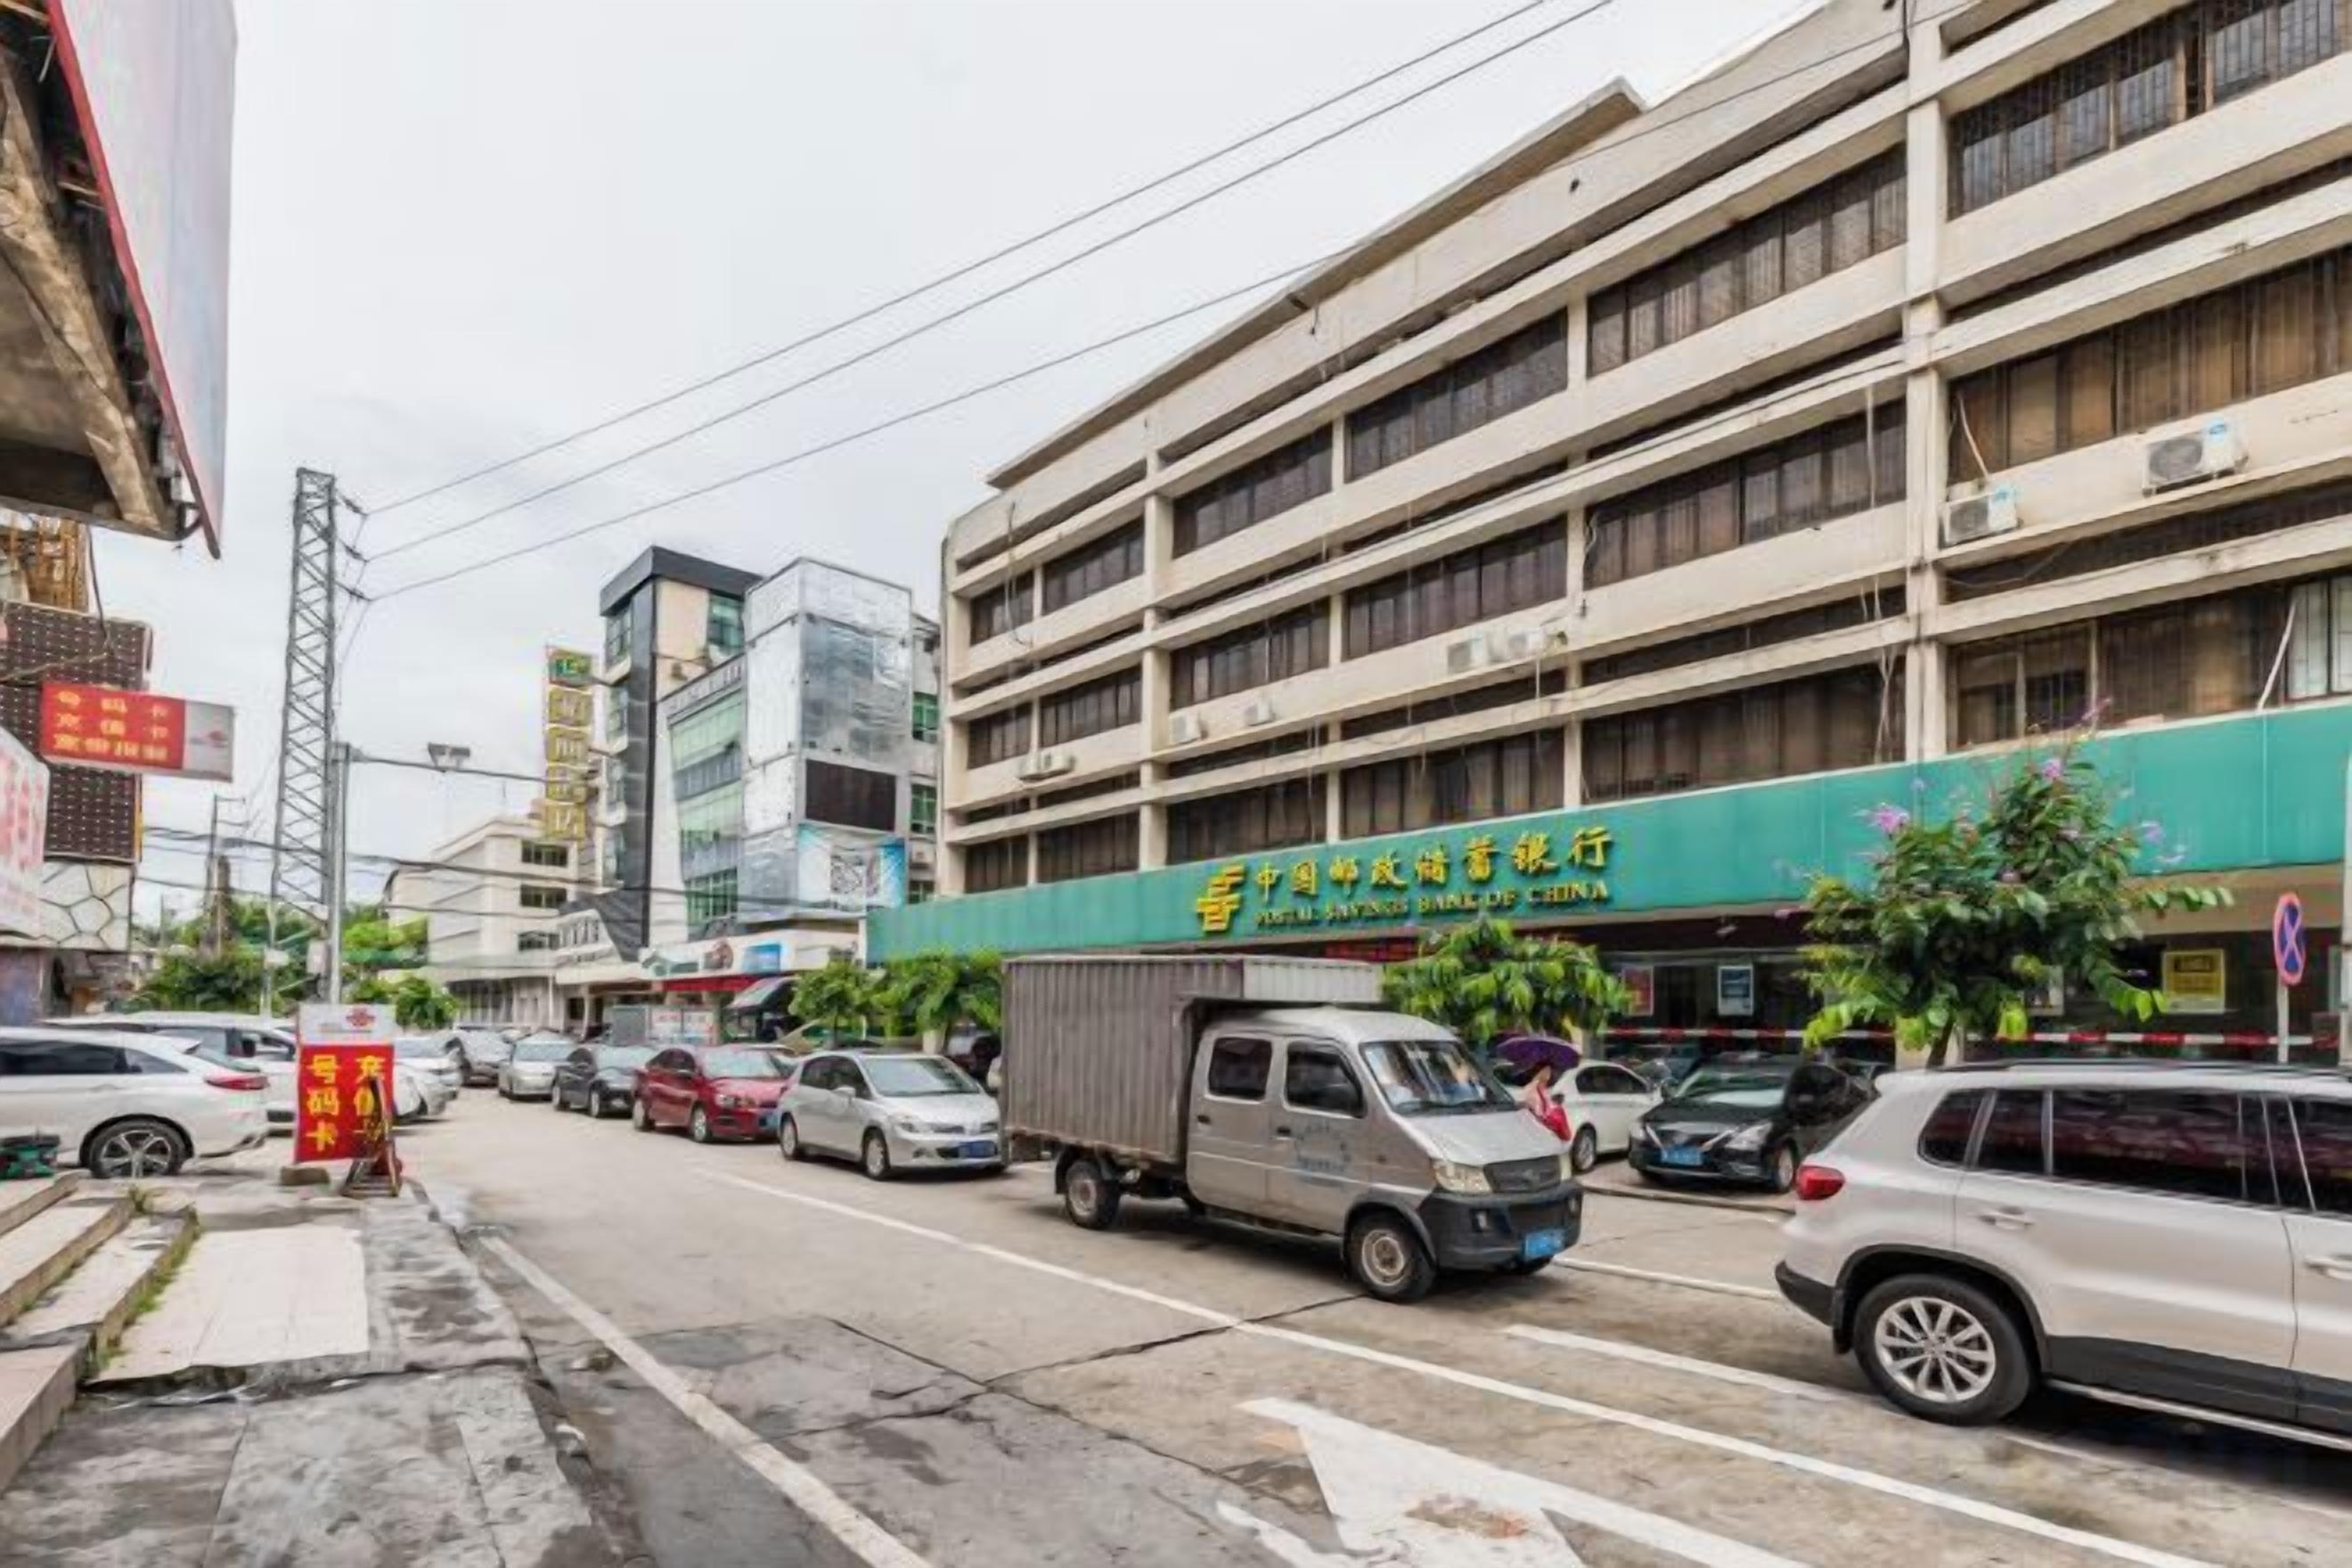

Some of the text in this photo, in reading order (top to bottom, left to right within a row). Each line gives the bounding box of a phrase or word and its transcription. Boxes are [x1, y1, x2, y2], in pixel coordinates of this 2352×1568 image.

[1254, 825, 1613, 902] 中国邮政储蓄银行
[1486, 887, 1518, 908] OF
[1528, 878, 1609, 903] CHINA
